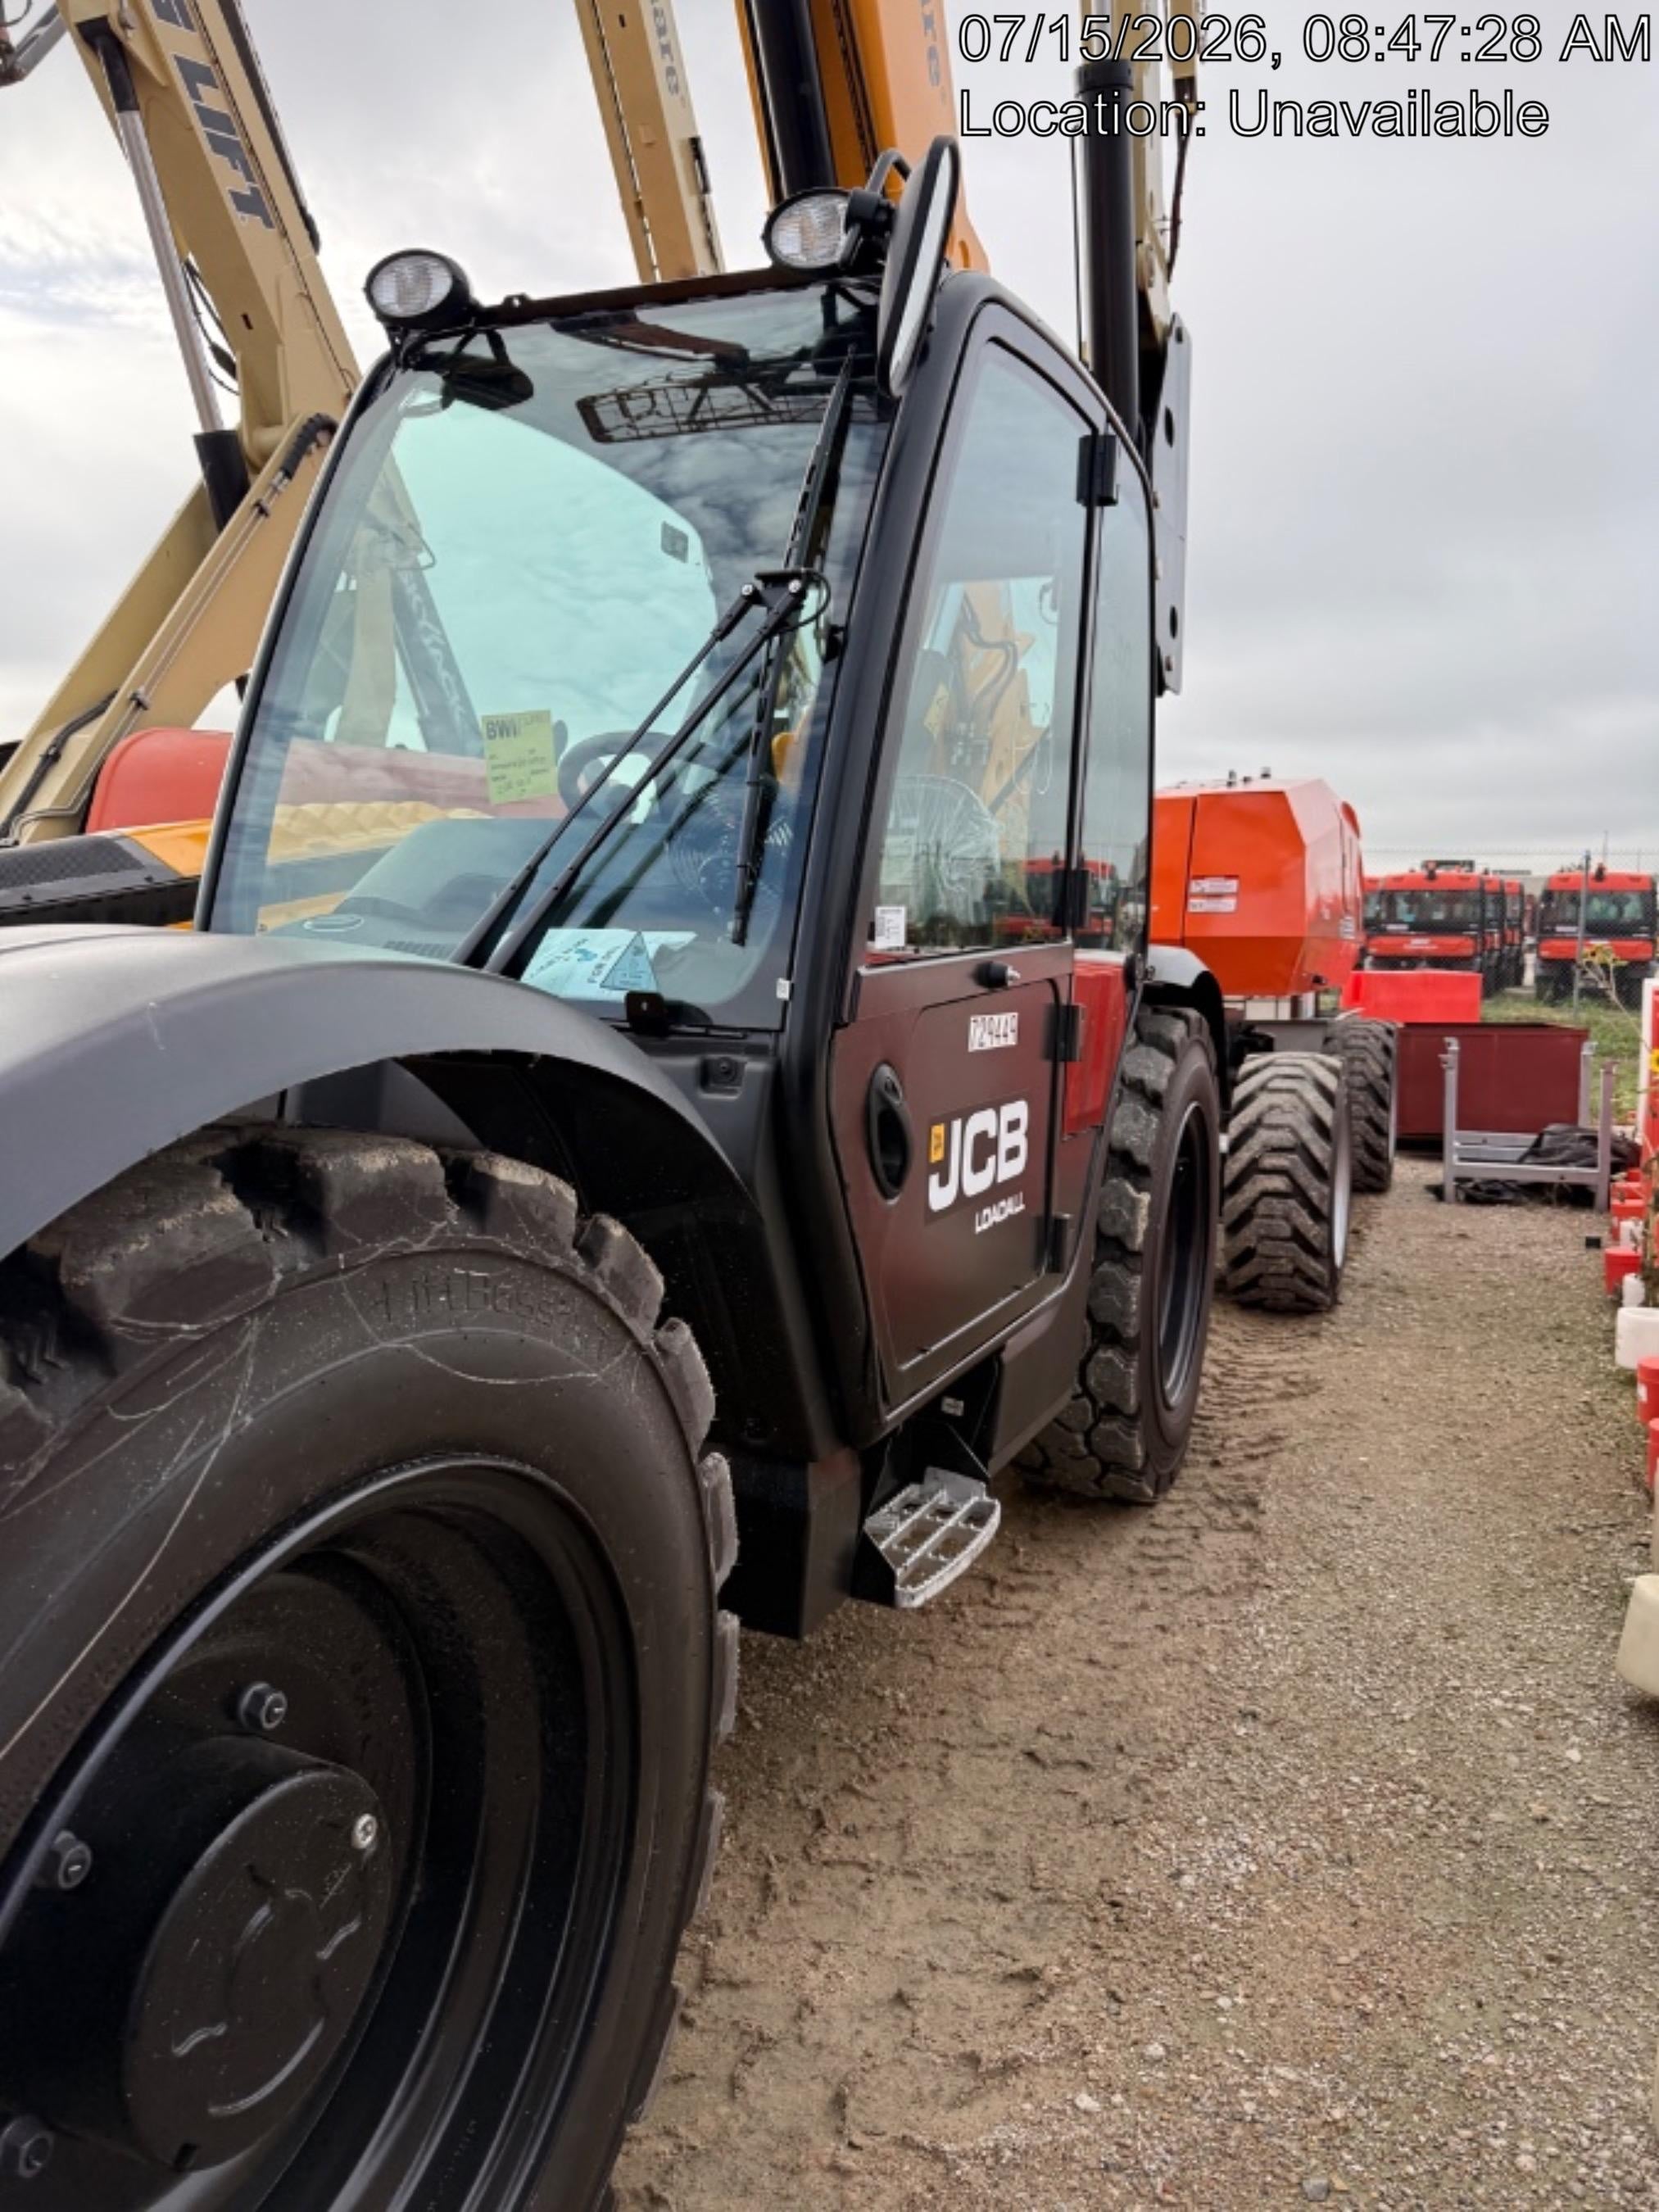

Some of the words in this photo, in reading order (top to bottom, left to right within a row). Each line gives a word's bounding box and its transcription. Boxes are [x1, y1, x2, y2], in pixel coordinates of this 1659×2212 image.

[173, 54, 275, 229] LIFT
[928, 1099, 1029, 1212] JCB
[974, 1191, 1026, 1234] LOADALL
